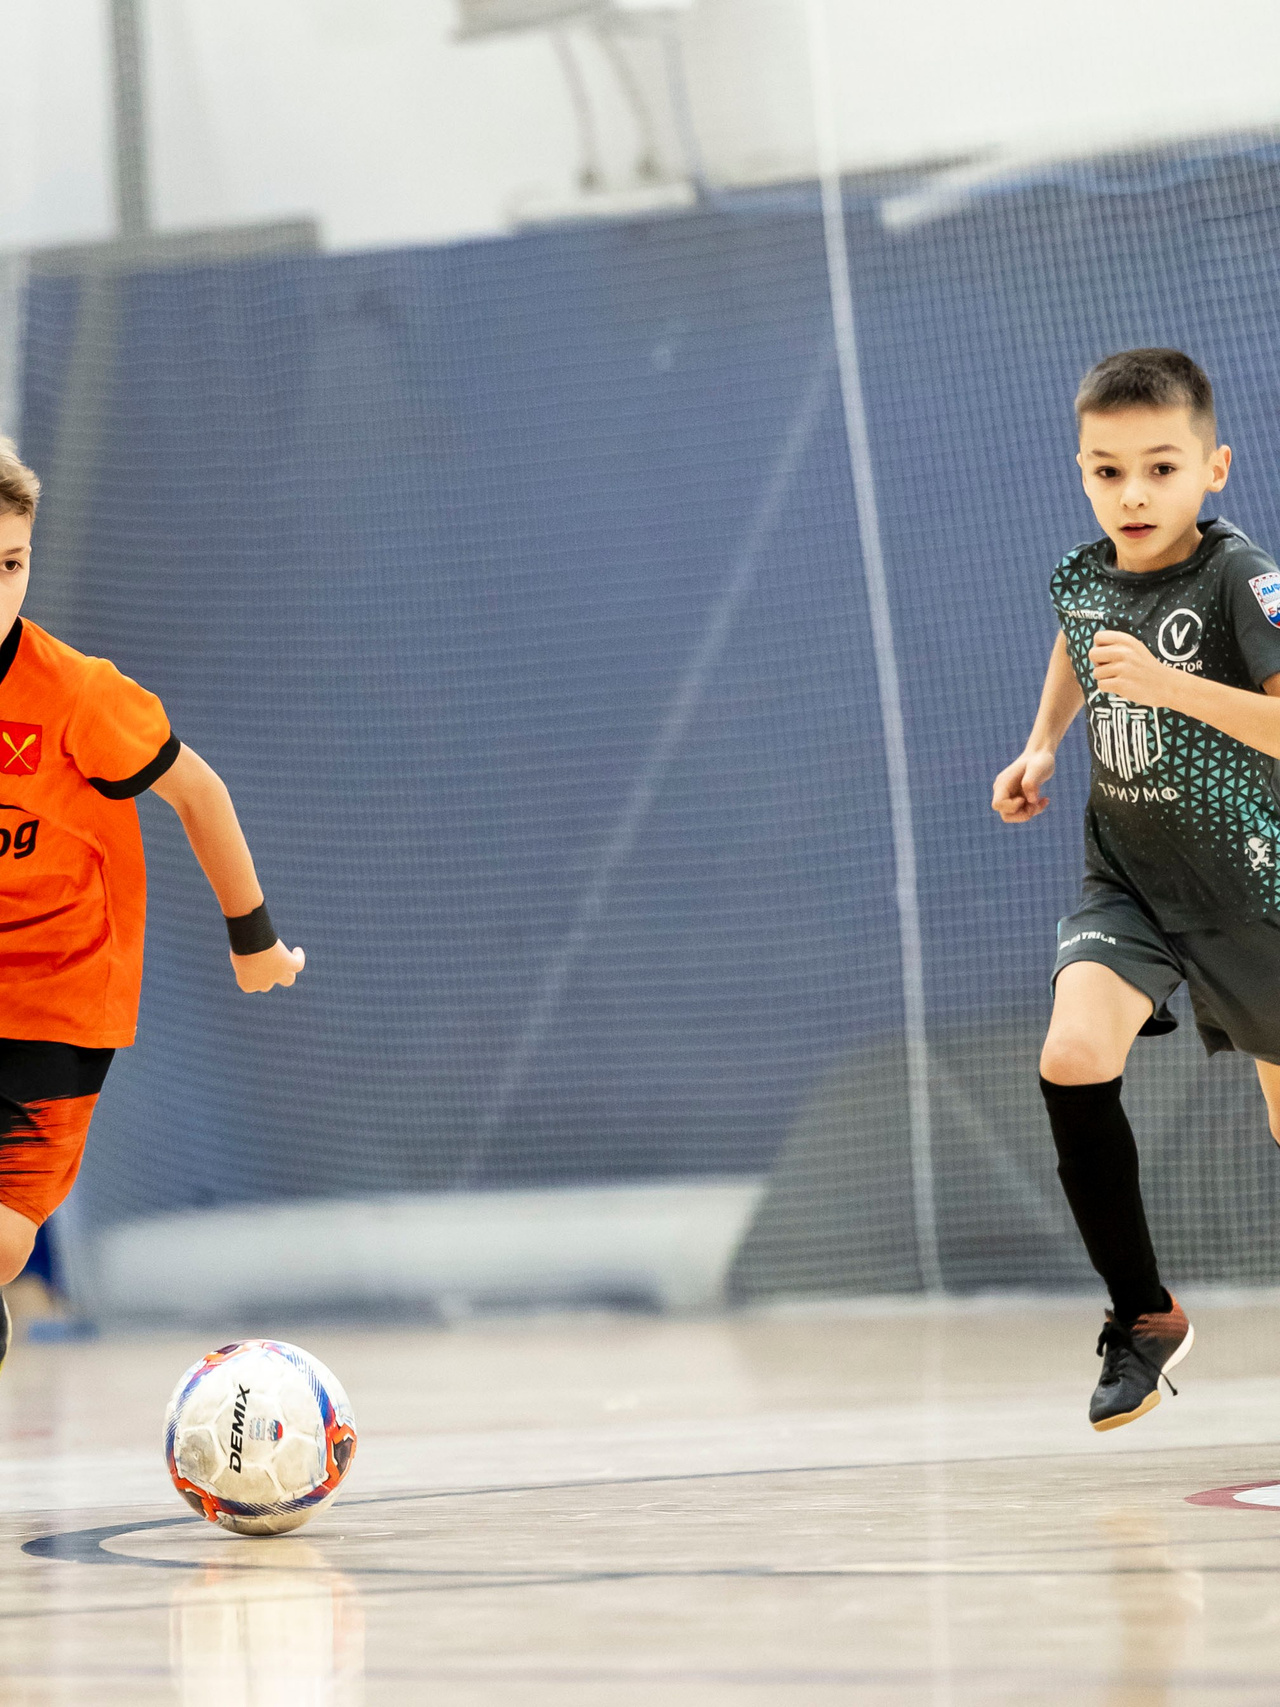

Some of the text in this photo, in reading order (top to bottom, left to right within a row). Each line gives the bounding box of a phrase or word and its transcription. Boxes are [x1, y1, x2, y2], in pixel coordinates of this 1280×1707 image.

[1157, 656, 1203, 672] CTOR
[1098, 782, 1178, 803] ТРИУМФ
[229, 1383, 251, 1474] DEMIX
